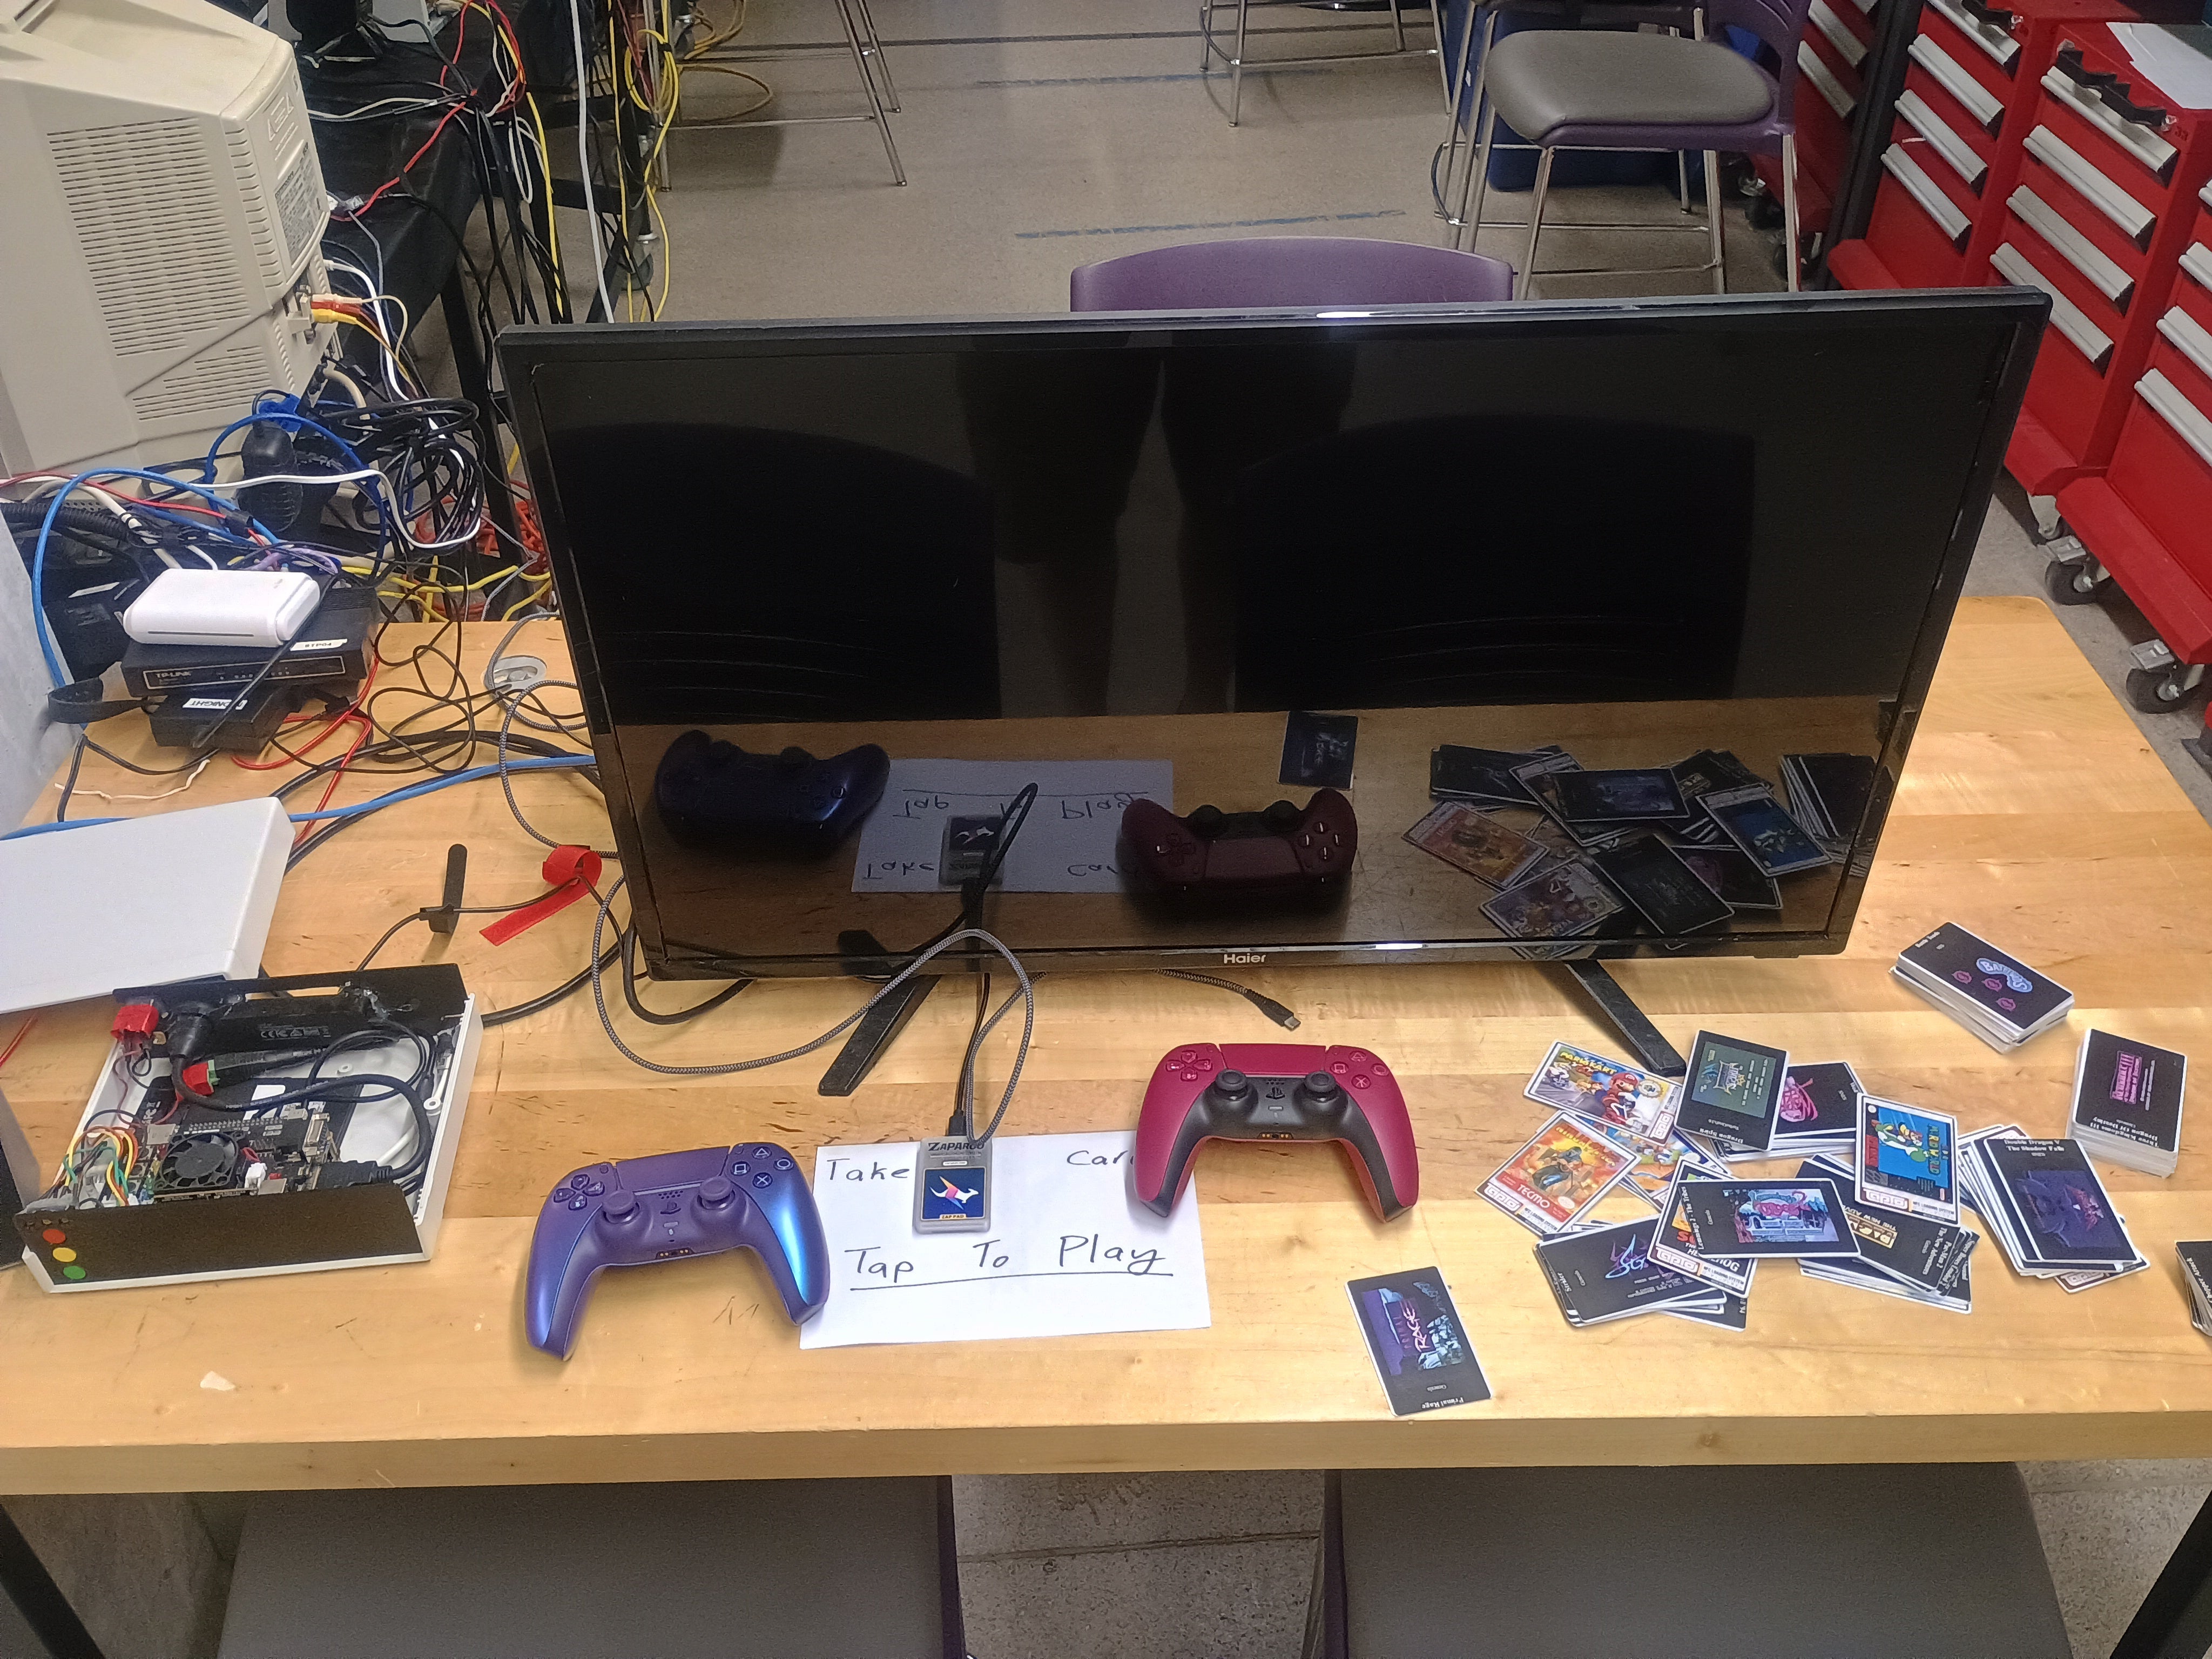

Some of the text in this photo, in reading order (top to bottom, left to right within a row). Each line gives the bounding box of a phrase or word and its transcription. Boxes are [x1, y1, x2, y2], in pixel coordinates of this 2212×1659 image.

[1223, 953, 1266, 964] Haier
[826, 1150, 1134, 1182] Take Car
[1517, 1184, 1550, 1209] TECMO
[844, 1233, 1166, 1283] Tap To Play
